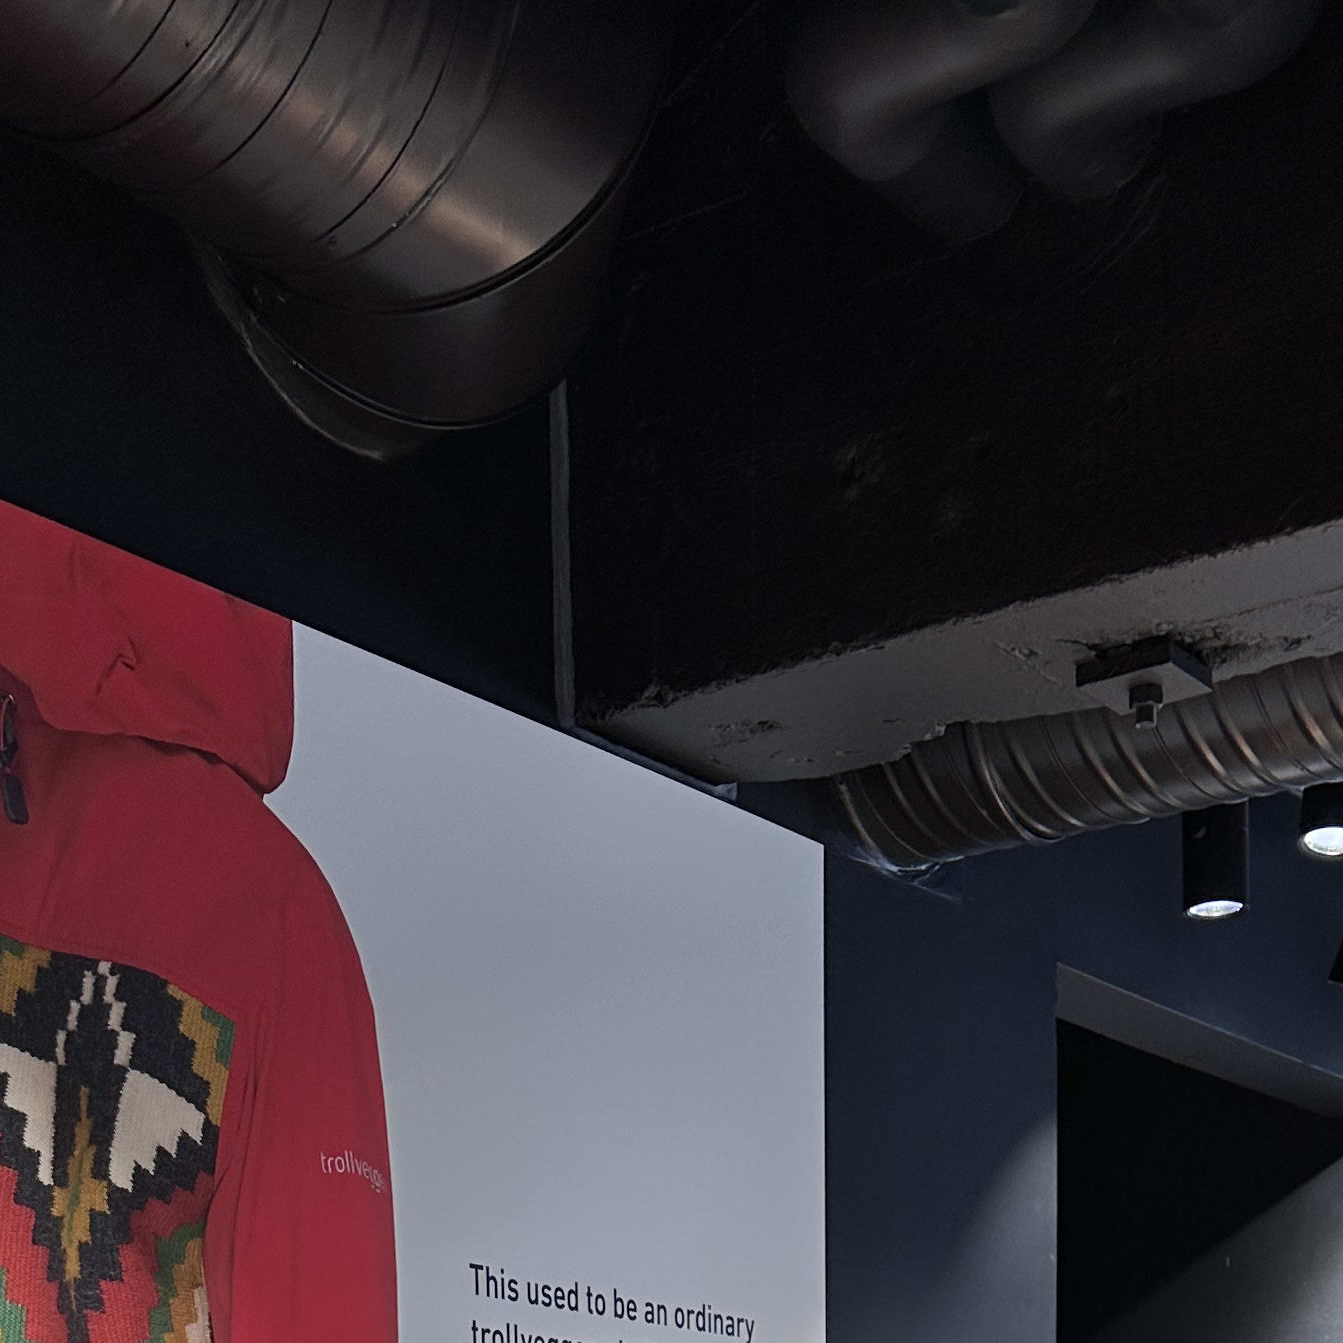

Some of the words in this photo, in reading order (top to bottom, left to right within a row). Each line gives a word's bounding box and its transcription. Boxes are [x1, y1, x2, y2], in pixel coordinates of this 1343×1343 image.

[470, 1263, 519, 1302] This
[527, 1282, 578, 1312] used
[587, 1286, 606, 1316] to
[614, 1288, 637, 1321] be
[644, 1300, 667, 1326] an
